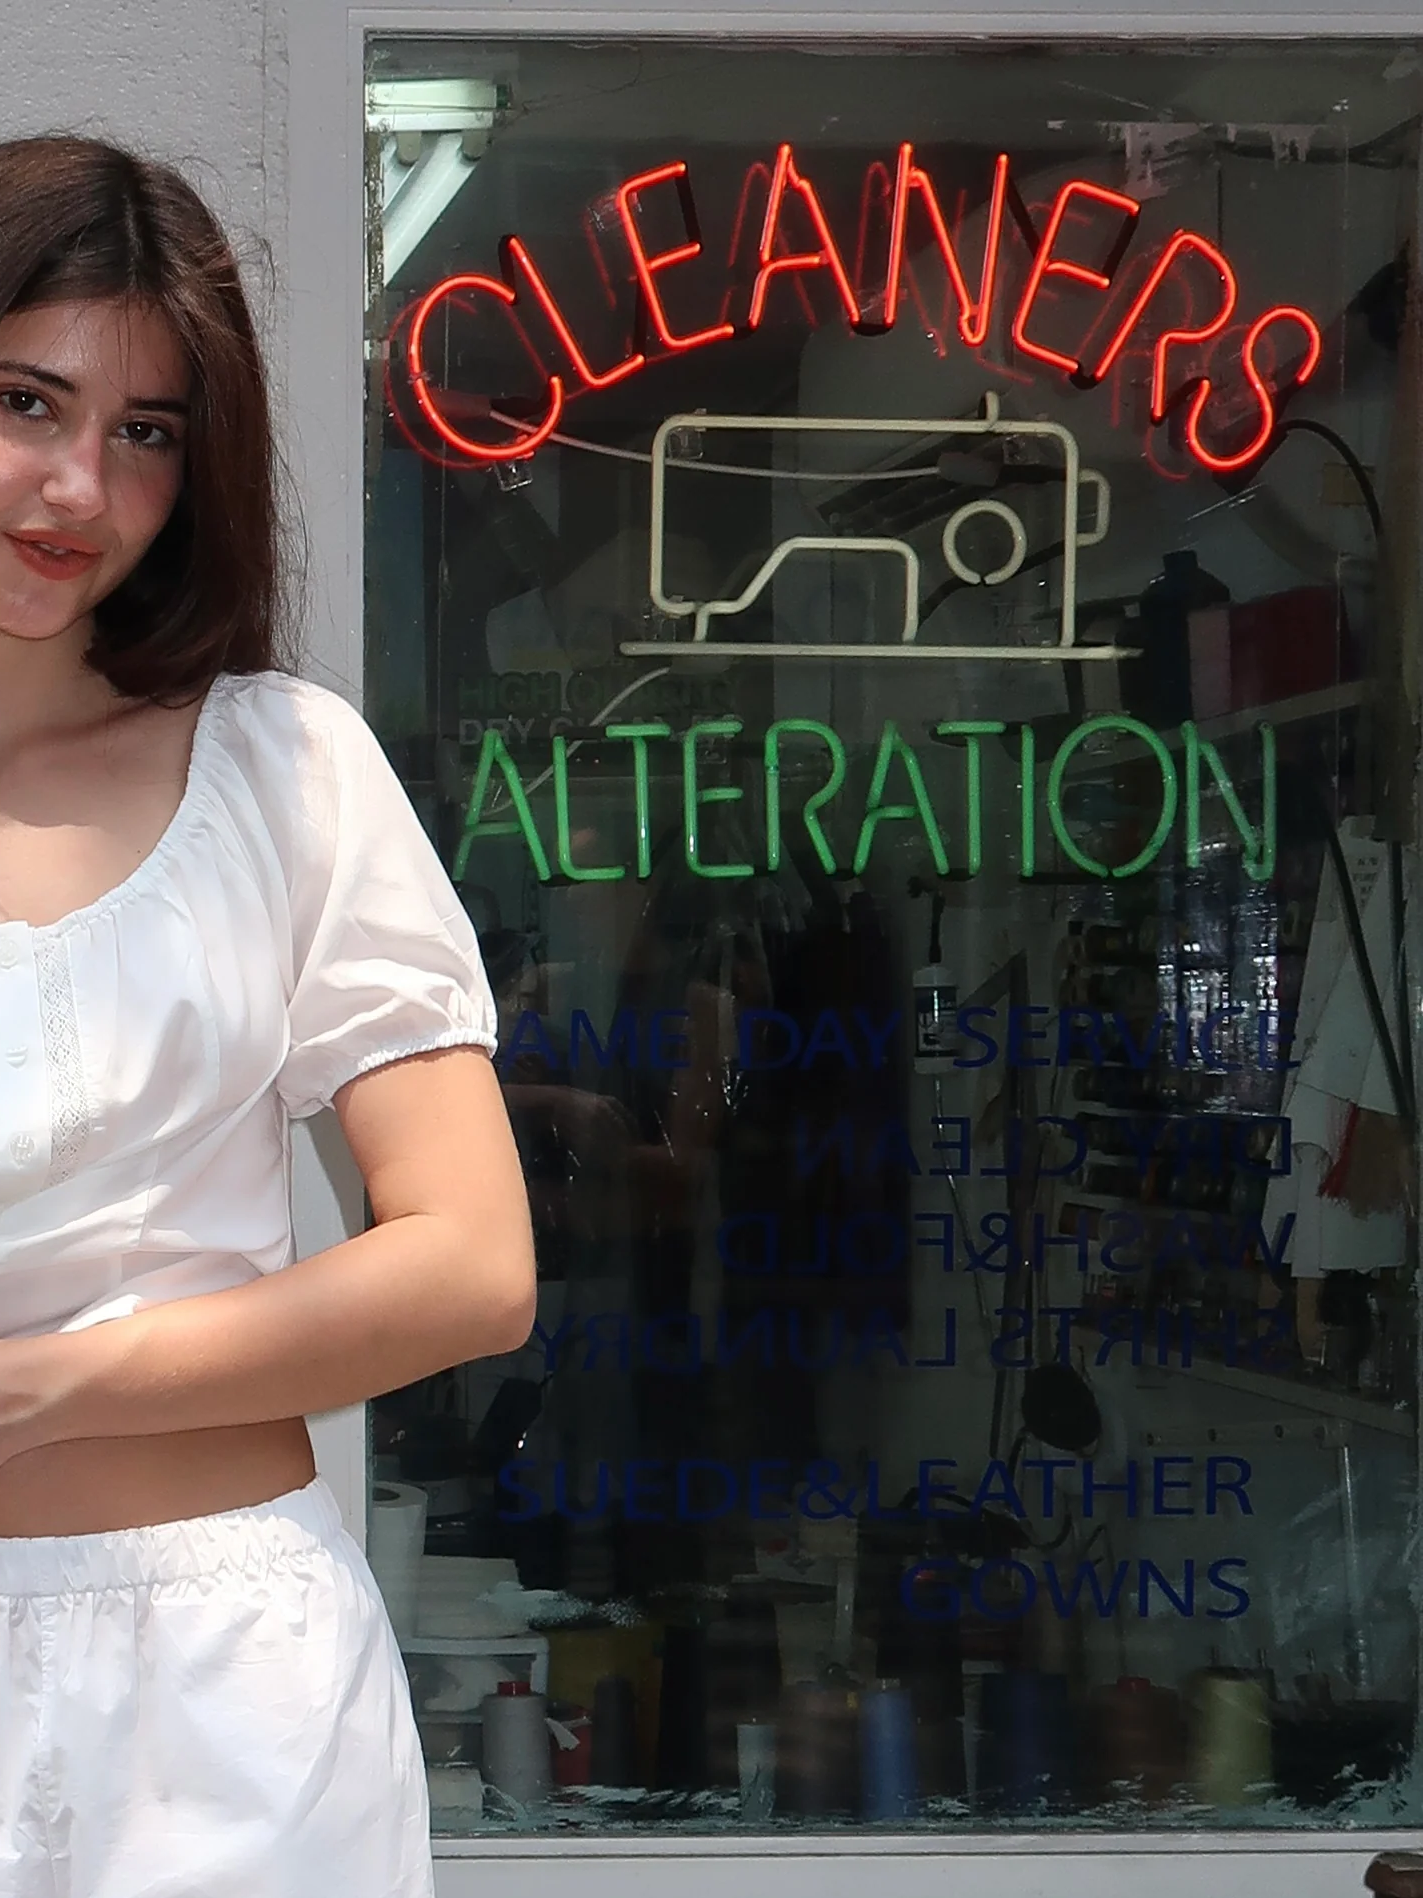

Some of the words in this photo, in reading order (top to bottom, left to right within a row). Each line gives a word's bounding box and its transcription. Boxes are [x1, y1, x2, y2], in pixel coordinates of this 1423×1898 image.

[409, 141, 1323, 472] CLEANERS
[454, 717, 1276, 882] ALTERATION
[736, 1009, 902, 1070] DAY
[952, 1005, 1300, 1071] SERVICE
[495, 1455, 1255, 1523] SUEDE&LEATHER
[898, 1556, 1251, 1620] GOWNS
